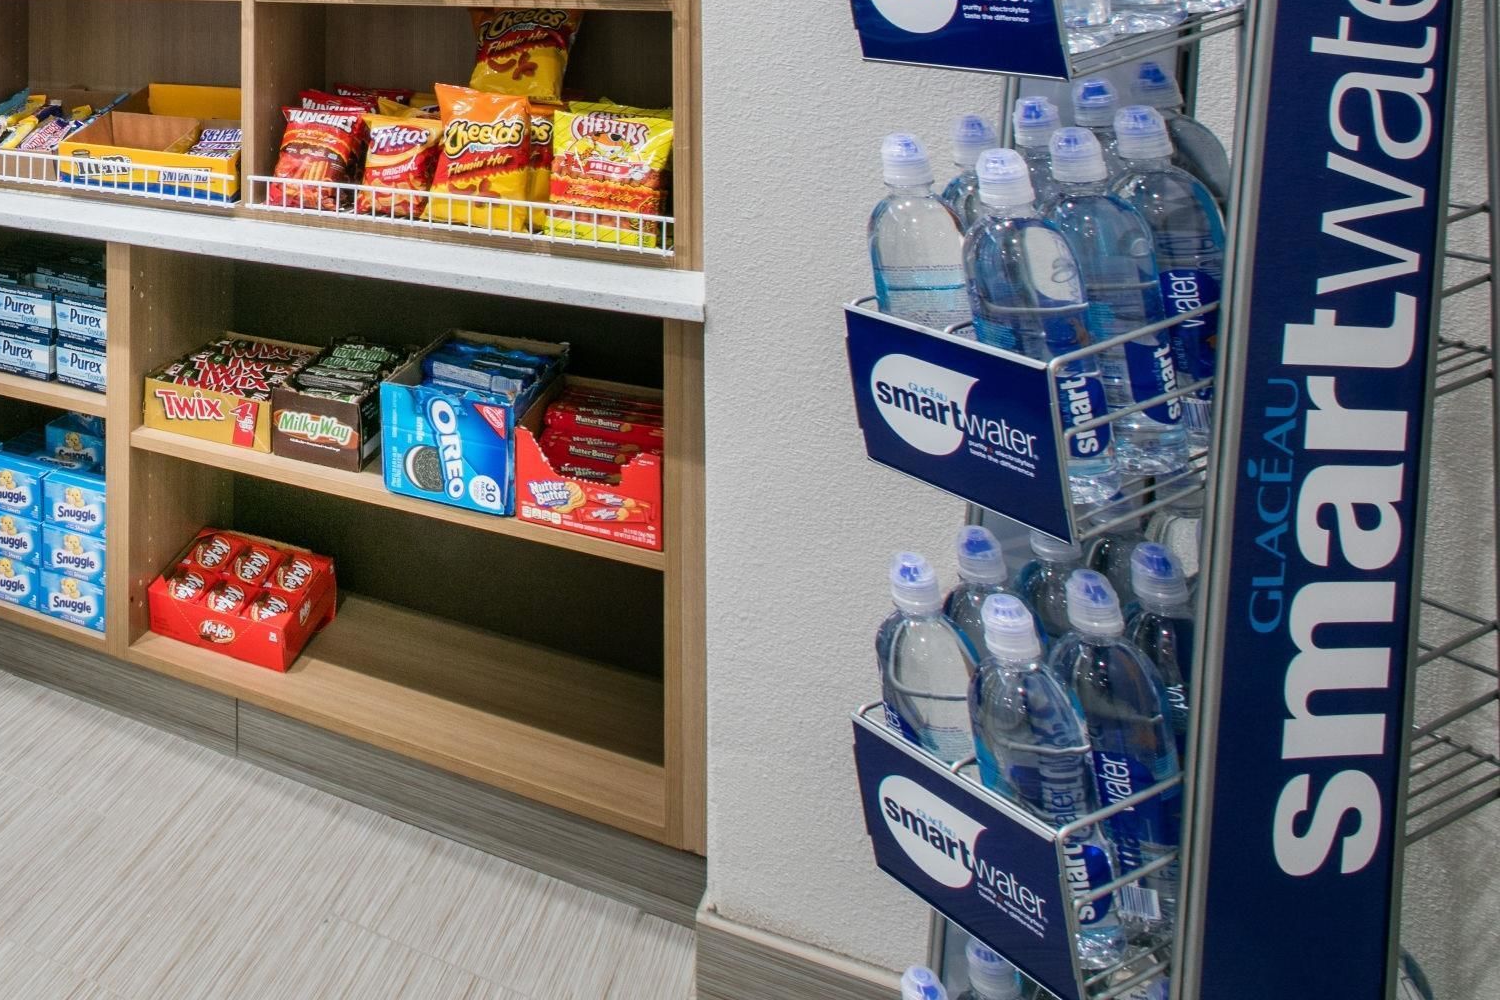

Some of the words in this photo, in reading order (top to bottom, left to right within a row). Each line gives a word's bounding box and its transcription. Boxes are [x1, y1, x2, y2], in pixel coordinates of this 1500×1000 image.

[989, 6, 1030, 14] electrolytes
[994, 14, 1029, 22] difference
[492, 10, 566, 38] Cheetos
[488, 37, 526, 51] Flamin'
[528, 32, 548, 41] Hot
[371, 126, 430, 153] Fritos
[446, 120, 524, 158] Cheetos
[572, 116, 648, 144] CHESTER'S
[382, 163, 417, 176] ORIGINAL
[448, 159, 483, 174] Flamin'
[486, 152, 511, 165] Hot
[590, 164, 620, 173] FRIES
[4, 297, 35, 315] Purex
[70, 309, 100, 328] Purex
[3, 341, 32, 360] Purex
[71, 354, 101, 373] Purex
[280, 413, 318, 439] Milky
[319, 418, 350, 444] Way
[576, 415, 597, 425] Nutter
[598, 418, 620, 428] Butter
[875, 381, 1037, 458] smartwater
[431, 399, 464, 498] OREO
[569, 446, 591, 456] Nutter
[592, 449, 615, 460] Butter
[486, 483, 496, 503] 30
[529, 481, 564, 494] Nutter
[535, 490, 569, 504] Butter
[58, 507, 96, 522] Snuggle
[1247, 378, 1299, 634] GLACÉAU
[57, 552, 95, 568] Snuggle
[53, 597, 91, 613] Snuggle
[883, 796, 1046, 919] smartwater
